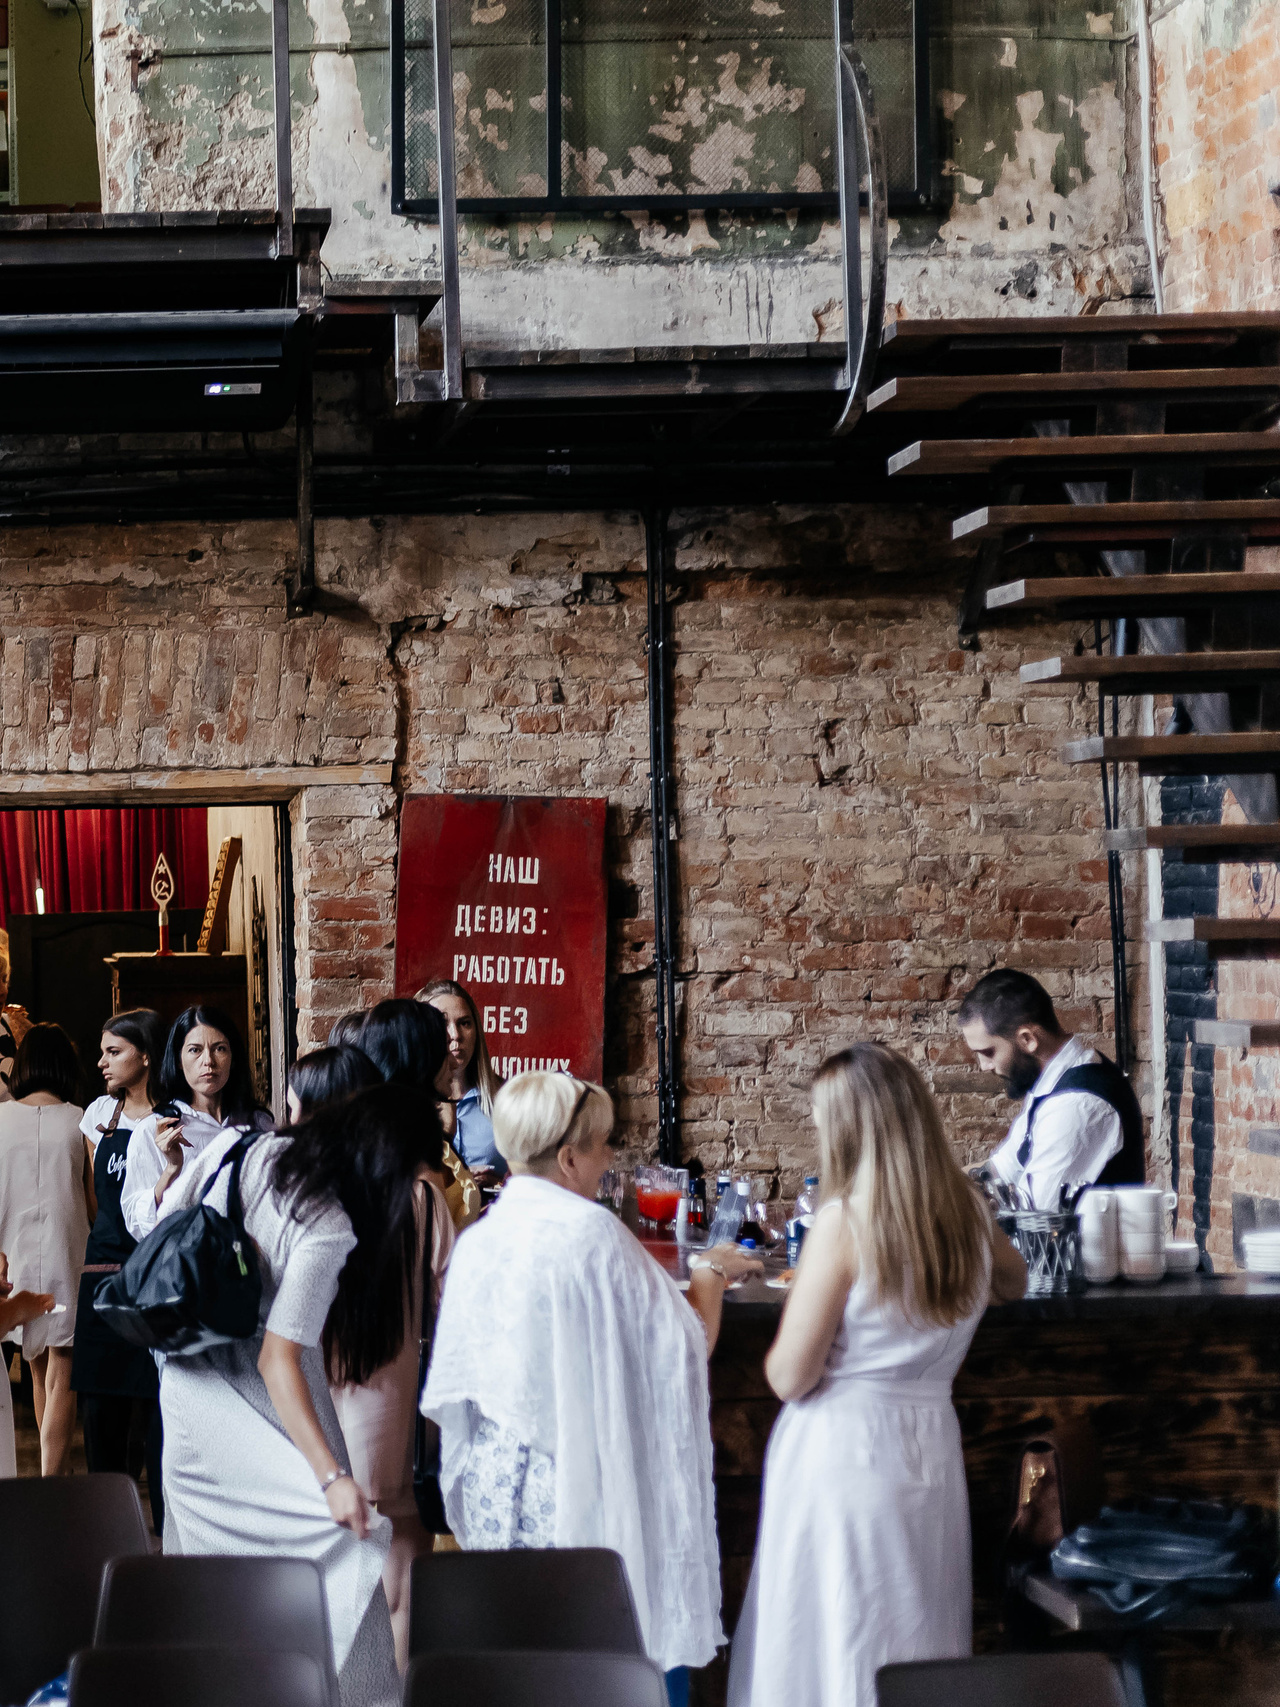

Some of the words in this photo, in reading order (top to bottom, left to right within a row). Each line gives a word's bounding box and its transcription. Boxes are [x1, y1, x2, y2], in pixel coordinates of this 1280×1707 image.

[488, 853, 540, 885] НАШ
[454, 904, 549, 938] ДЕВИЗ:
[453, 954, 566, 986] РАБОТАТЬ
[483, 1005, 528, 1035] БЕЗ
